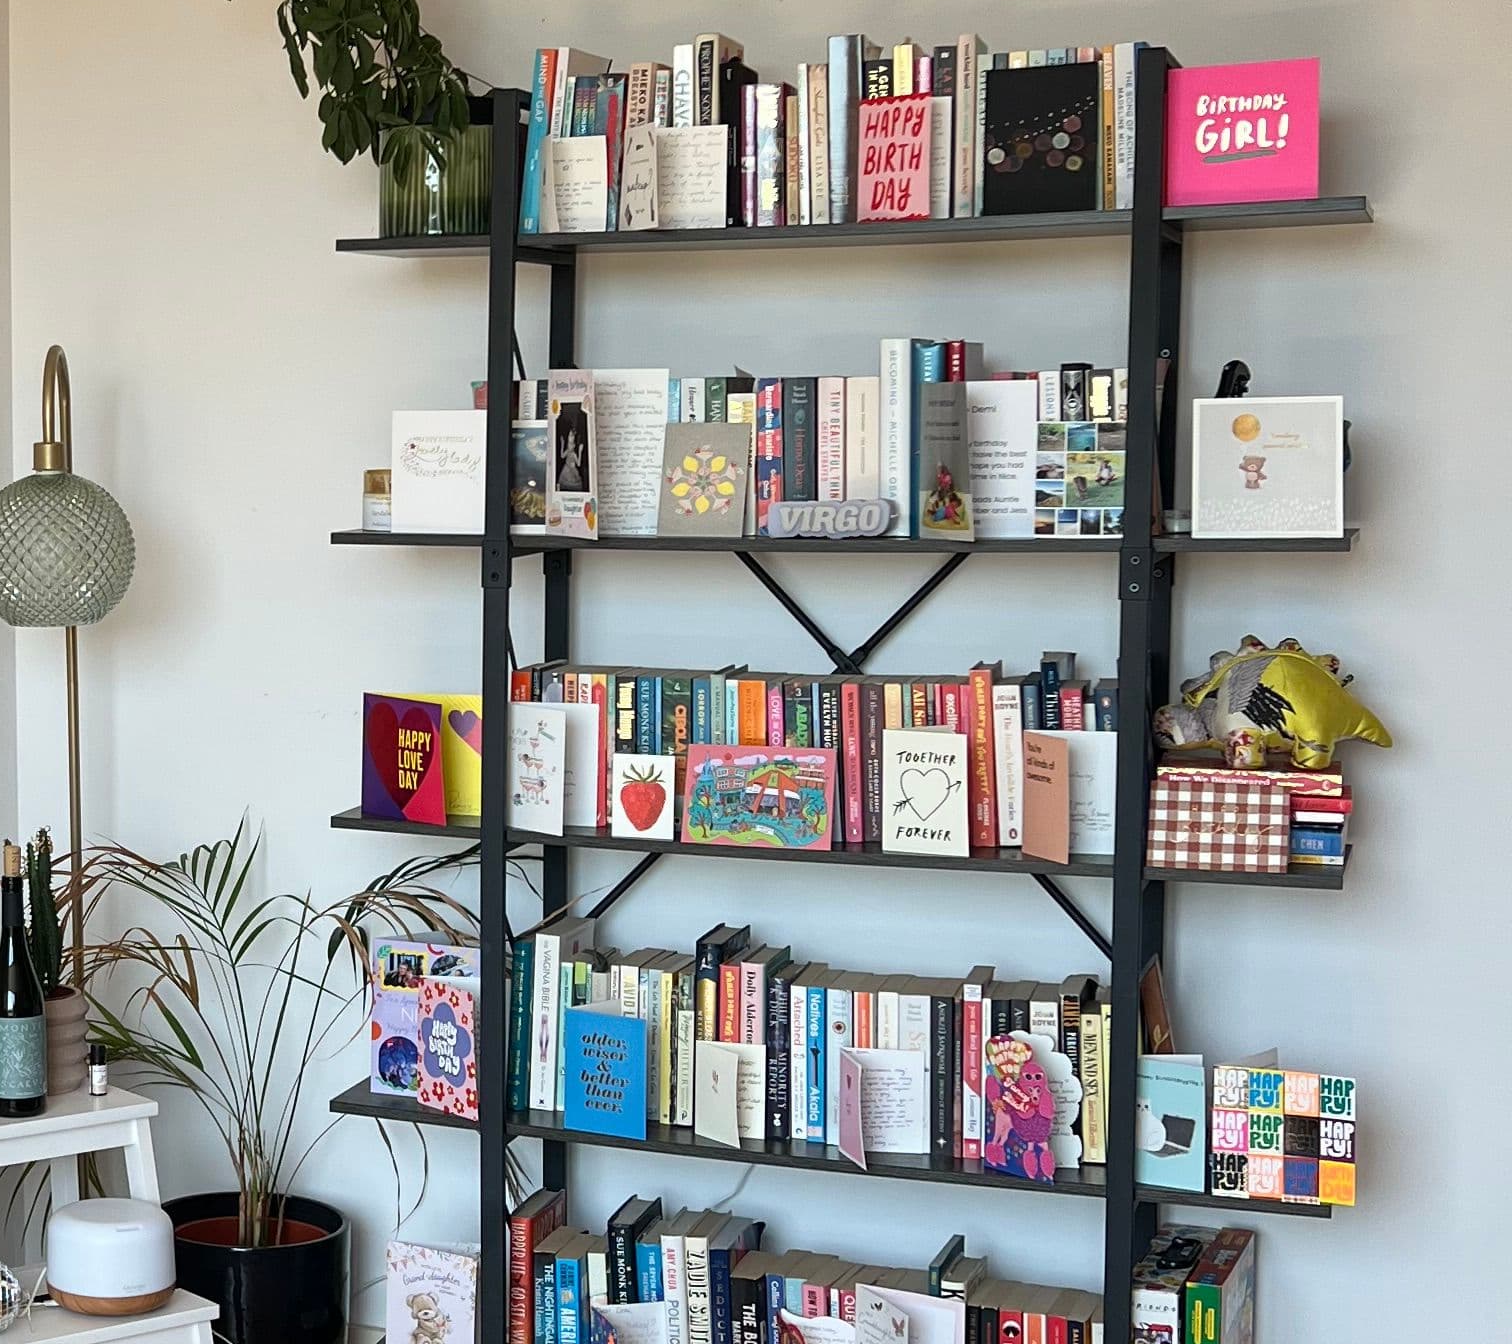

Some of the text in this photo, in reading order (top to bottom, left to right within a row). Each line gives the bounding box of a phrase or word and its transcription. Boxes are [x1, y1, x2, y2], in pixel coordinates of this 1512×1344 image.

[700, 44, 713, 92] PROPHET
[534, 54, 549, 123] MIND GAP
[639, 68, 649, 104] MIEKO
[1125, 91, 1133, 117] SONG
[1196, 93, 1287, 117] BIRTHDAY
[864, 106, 925, 140] HAPPY
[1194, 113, 1290, 155] GIRL!
[863, 141, 923, 176] BIRTH
[870, 177, 912, 212] DAY
[888, 349, 898, 474] BECOMING MICHELLE
[764, 385, 774, 462] Bernardine Evaristo
[830, 390, 841, 472] TINY BEAUTIFUL
[778, 505, 881, 534] VIRGO
[640, 681, 650, 734] SUE MONK
[697, 688, 706, 726] SORROW
[771, 695, 781, 720] LOVE
[822, 692, 831, 726] EVELYN
[1046, 690, 1058, 730] Think
[398, 728, 432, 752] HAPPY
[398, 749, 424, 771] LOVE
[896, 750, 957, 767] TOGETHER
[398, 770, 418, 790] DAY
[1169, 774, 1191, 782] How
[895, 826, 952, 842] FOREVER
[1300, 839, 1325, 851] CHEN
[541, 949, 553, 1013] VAGINA BIBLE
[744, 970, 757, 998] Dolly
[778, 991, 788, 1025] PHILIP
[809, 993, 820, 1038] Natives
[968, 1005, 976, 1019] you
[793, 996, 804, 1046] Attached
[970, 1034, 978, 1050] heal
[582, 1047, 628, 1061] wiser
[438, 1055, 461, 1076] DAY
[596, 1060, 613, 1072] &
[580, 1070, 630, 1088] better
[768, 1058, 777, 1102] REPORT
[777, 1052, 787, 1110] MINORITY
[1214, 1068, 1248, 1088] HAP
[1249, 1071, 1285, 1090] HAP
[1320, 1077, 1355, 1097] HAP
[585, 1084, 624, 1100] than
[1214, 1087, 1248, 1108] PY!
[1249, 1089, 1281, 1109] PY!
[809, 1086, 820, 1122] Akala
[1320, 1095, 1353, 1116] PY!
[968, 1119, 978, 1133] Hay
[1212, 1110, 1248, 1130] HAP
[1249, 1113, 1284, 1133] HAP
[1320, 1120, 1355, 1140] HAP
[1212, 1129, 1245, 1149] PY!
[1249, 1131, 1281, 1151] PY!
[1320, 1138, 1353, 1159] PY!
[1213, 1153, 1248, 1173] HAP
[1213, 1171, 1246, 1192] PY!
[511, 1222, 526, 1259] HARPER
[616, 1236, 626, 1289] SUE MONK
[666, 1248, 676, 1265] AMY
[544, 1263, 554, 1283] THE
[667, 1268, 677, 1290] CHUA
[688, 1250, 708, 1300] ZADIE
[511, 1287, 526, 1300] GO
[770, 1280, 780, 1308] Collins
[807, 1290, 817, 1305] HOW
[511, 1303, 526, 1318] SET
[742, 1303, 756, 1328] THE
